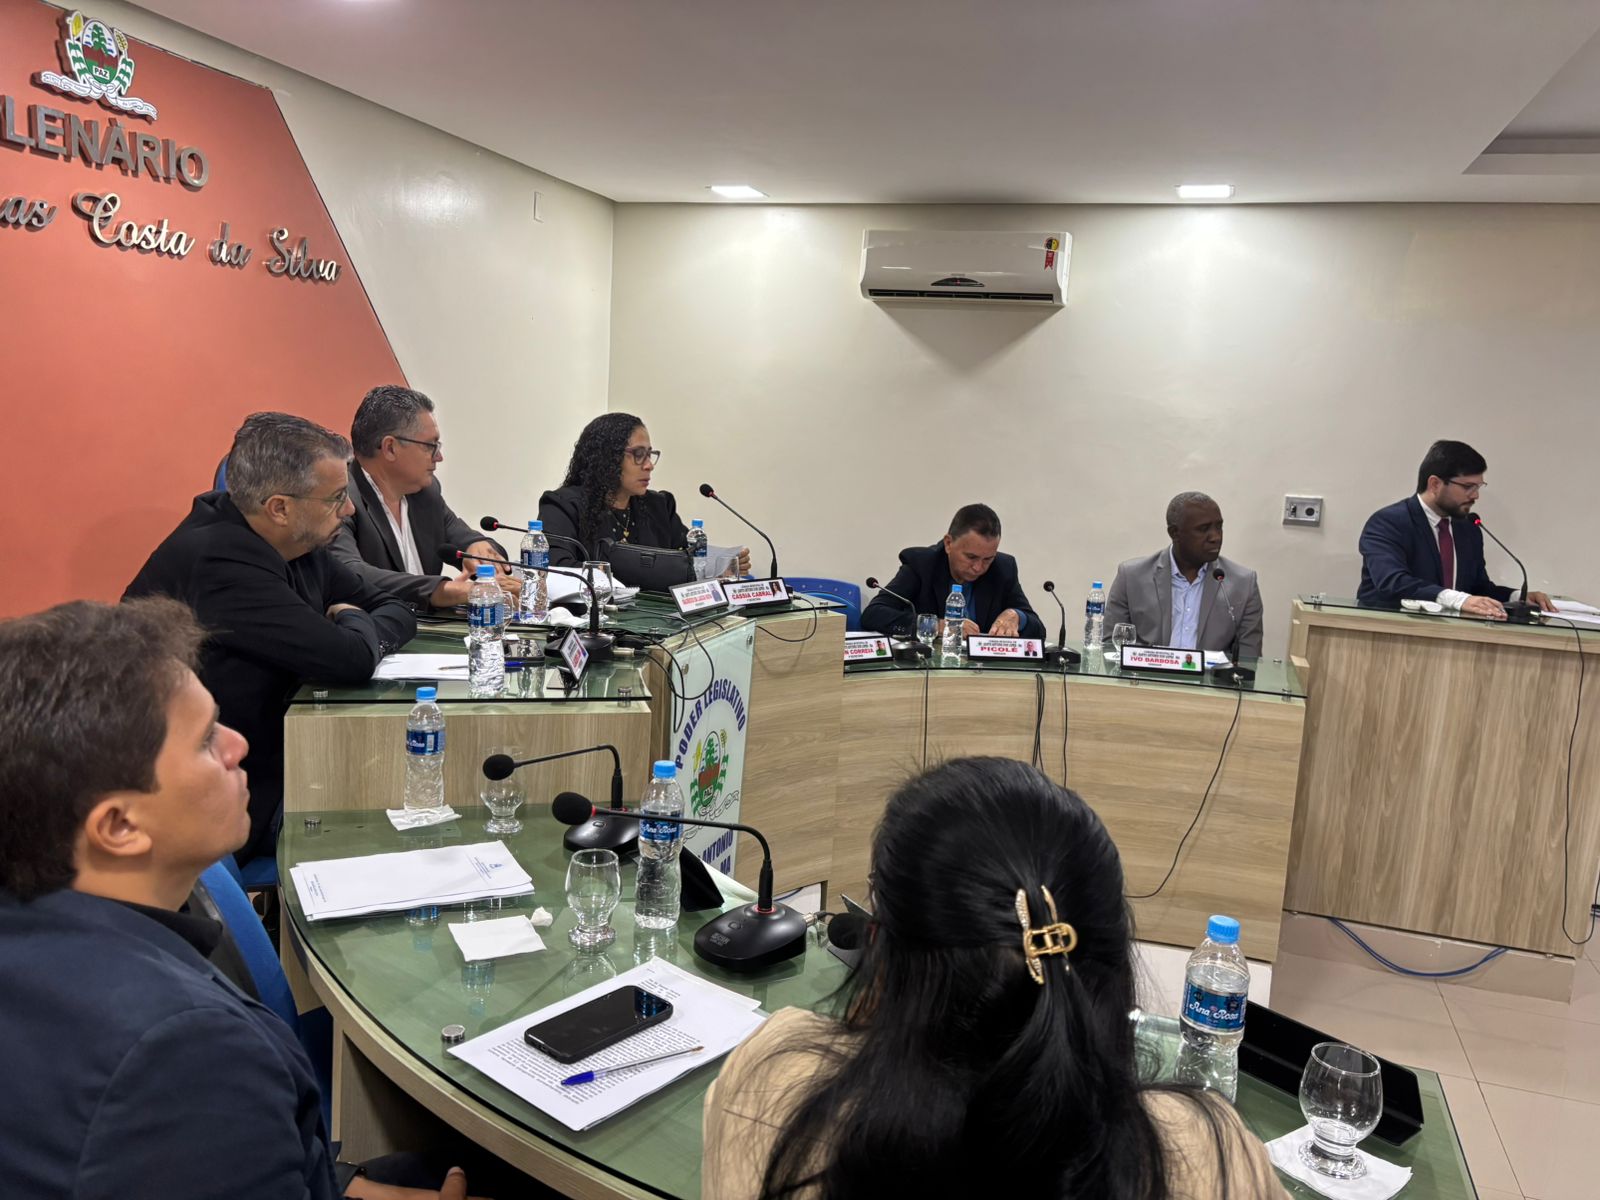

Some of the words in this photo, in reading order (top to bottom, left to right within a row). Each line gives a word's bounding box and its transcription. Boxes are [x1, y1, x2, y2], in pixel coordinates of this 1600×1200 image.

[94, 67, 108, 78] PAZ
[75, 193, 195, 256] Costa
[210, 222, 252, 266] da
[269, 228, 341, 280] Silva
[675, 698, 703, 770] PODER
[703, 678, 746, 732] LEGISLATIVO
[1189, 1001, 1210, 1017] Ana
[1213, 1009, 1239, 1020] Rosa
